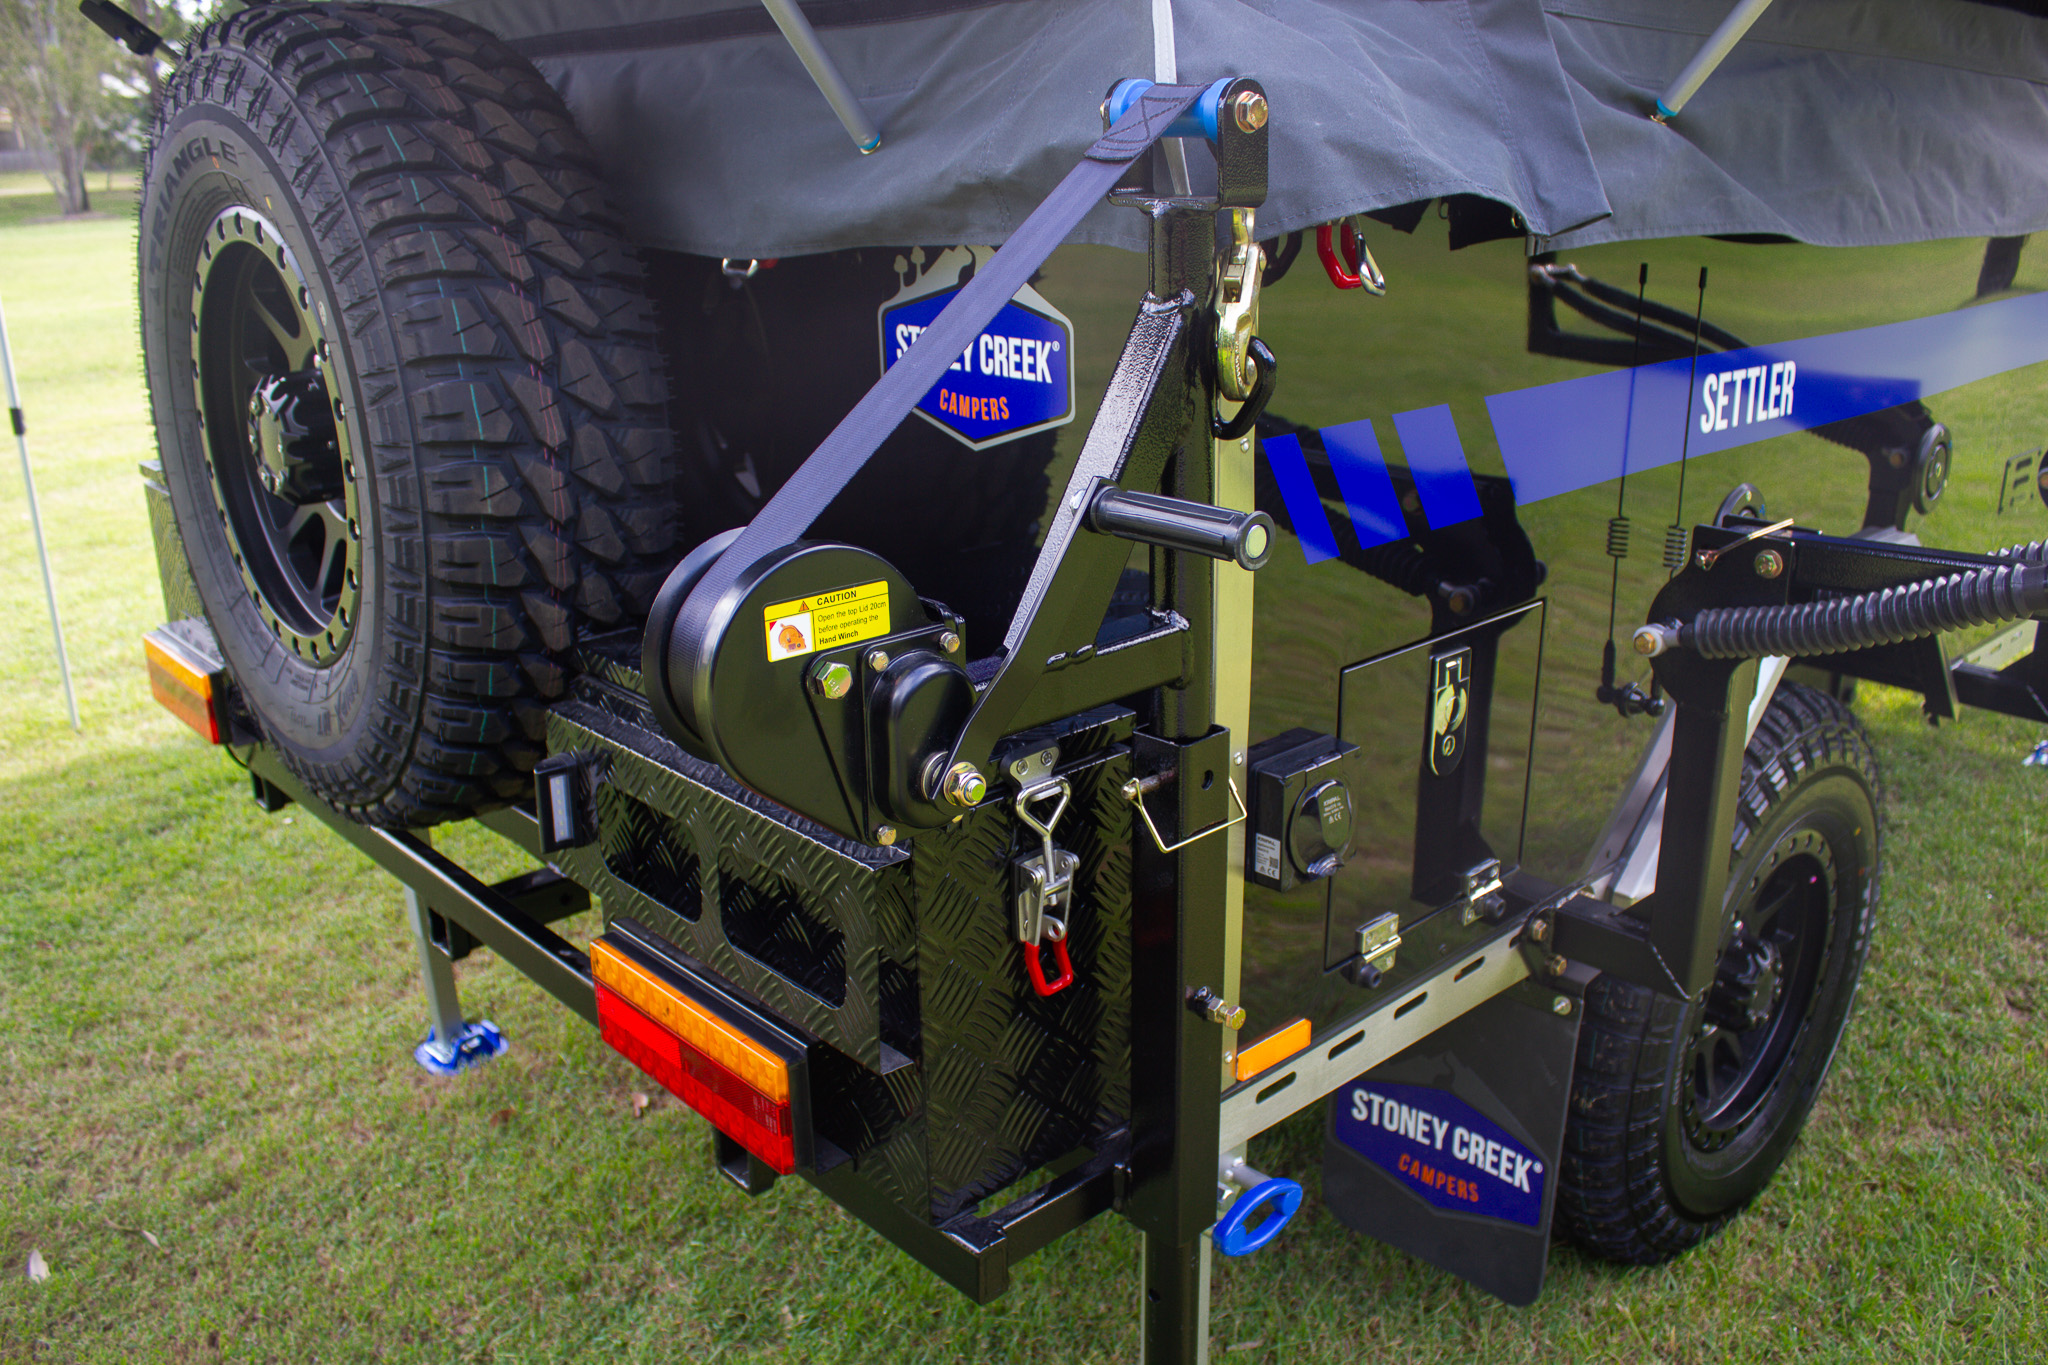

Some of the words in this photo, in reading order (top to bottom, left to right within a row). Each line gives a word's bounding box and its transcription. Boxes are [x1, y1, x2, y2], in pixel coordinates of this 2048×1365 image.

[151, 136, 239, 276] TRIANGLE
[896, 323, 974, 372] STY
[939, 388, 1010, 421] CAMPERS
[1700, 360, 1797, 434] SETTLER
[816, 590, 857, 606] CAUTION
[817, 613, 835, 624] Open
[836, 608, 847, 618] the
[848, 607, 858, 618] top
[858, 604, 869, 613] Lid
[869, 600, 887, 611] 20cm
[818, 623, 839, 634] before
[839, 617, 868, 630] operating
[868, 614, 879, 622] the
[819, 634, 837, 645] Hand
[837, 630, 859, 641] Winch
[1351, 1088, 1450, 1151] STONEY
[1398, 1153, 1480, 1203] CAMPERS
